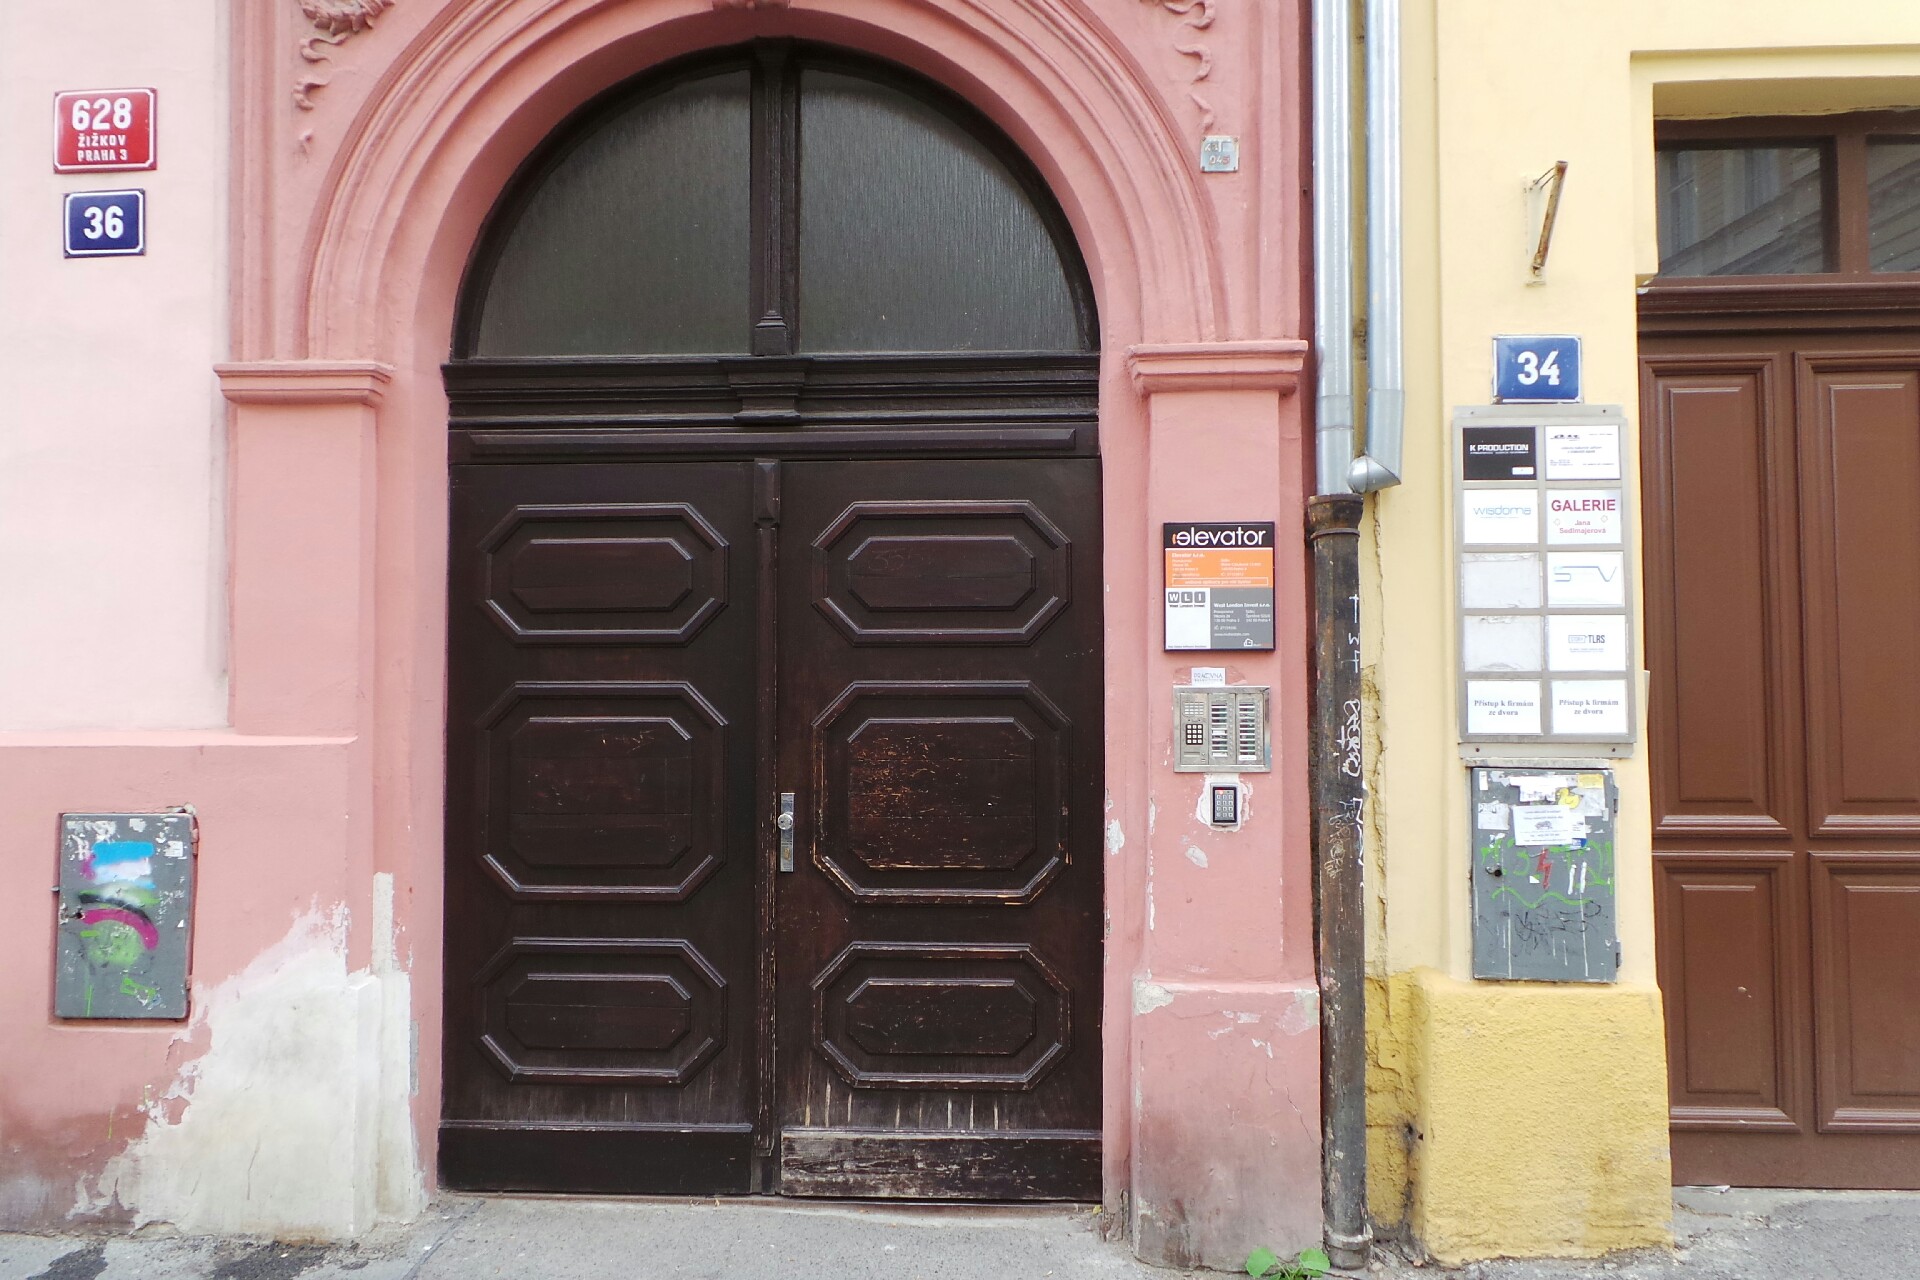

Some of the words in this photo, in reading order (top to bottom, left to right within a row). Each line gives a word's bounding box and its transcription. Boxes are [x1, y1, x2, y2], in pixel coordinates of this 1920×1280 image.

[72, 97, 132, 130] 628
[77, 132, 126, 148] ŽIŽKOV
[77, 149, 116, 162] PRAHA
[119, 149, 128, 161] 3
[83, 205, 124, 240] 36
[1517, 349, 1560, 385] 34
[1469, 444, 1476, 452] K
[1477, 443, 1529, 452] PRODUCTION
[1551, 499, 1616, 511] GALERIE
[1176, 527, 1266, 546] elevator
[1474, 699, 1499, 708] Přístup
[1501, 699, 1505, 707] k
[1507, 699, 1534, 707] firmám
[1558, 699, 1584, 707] Přístup
